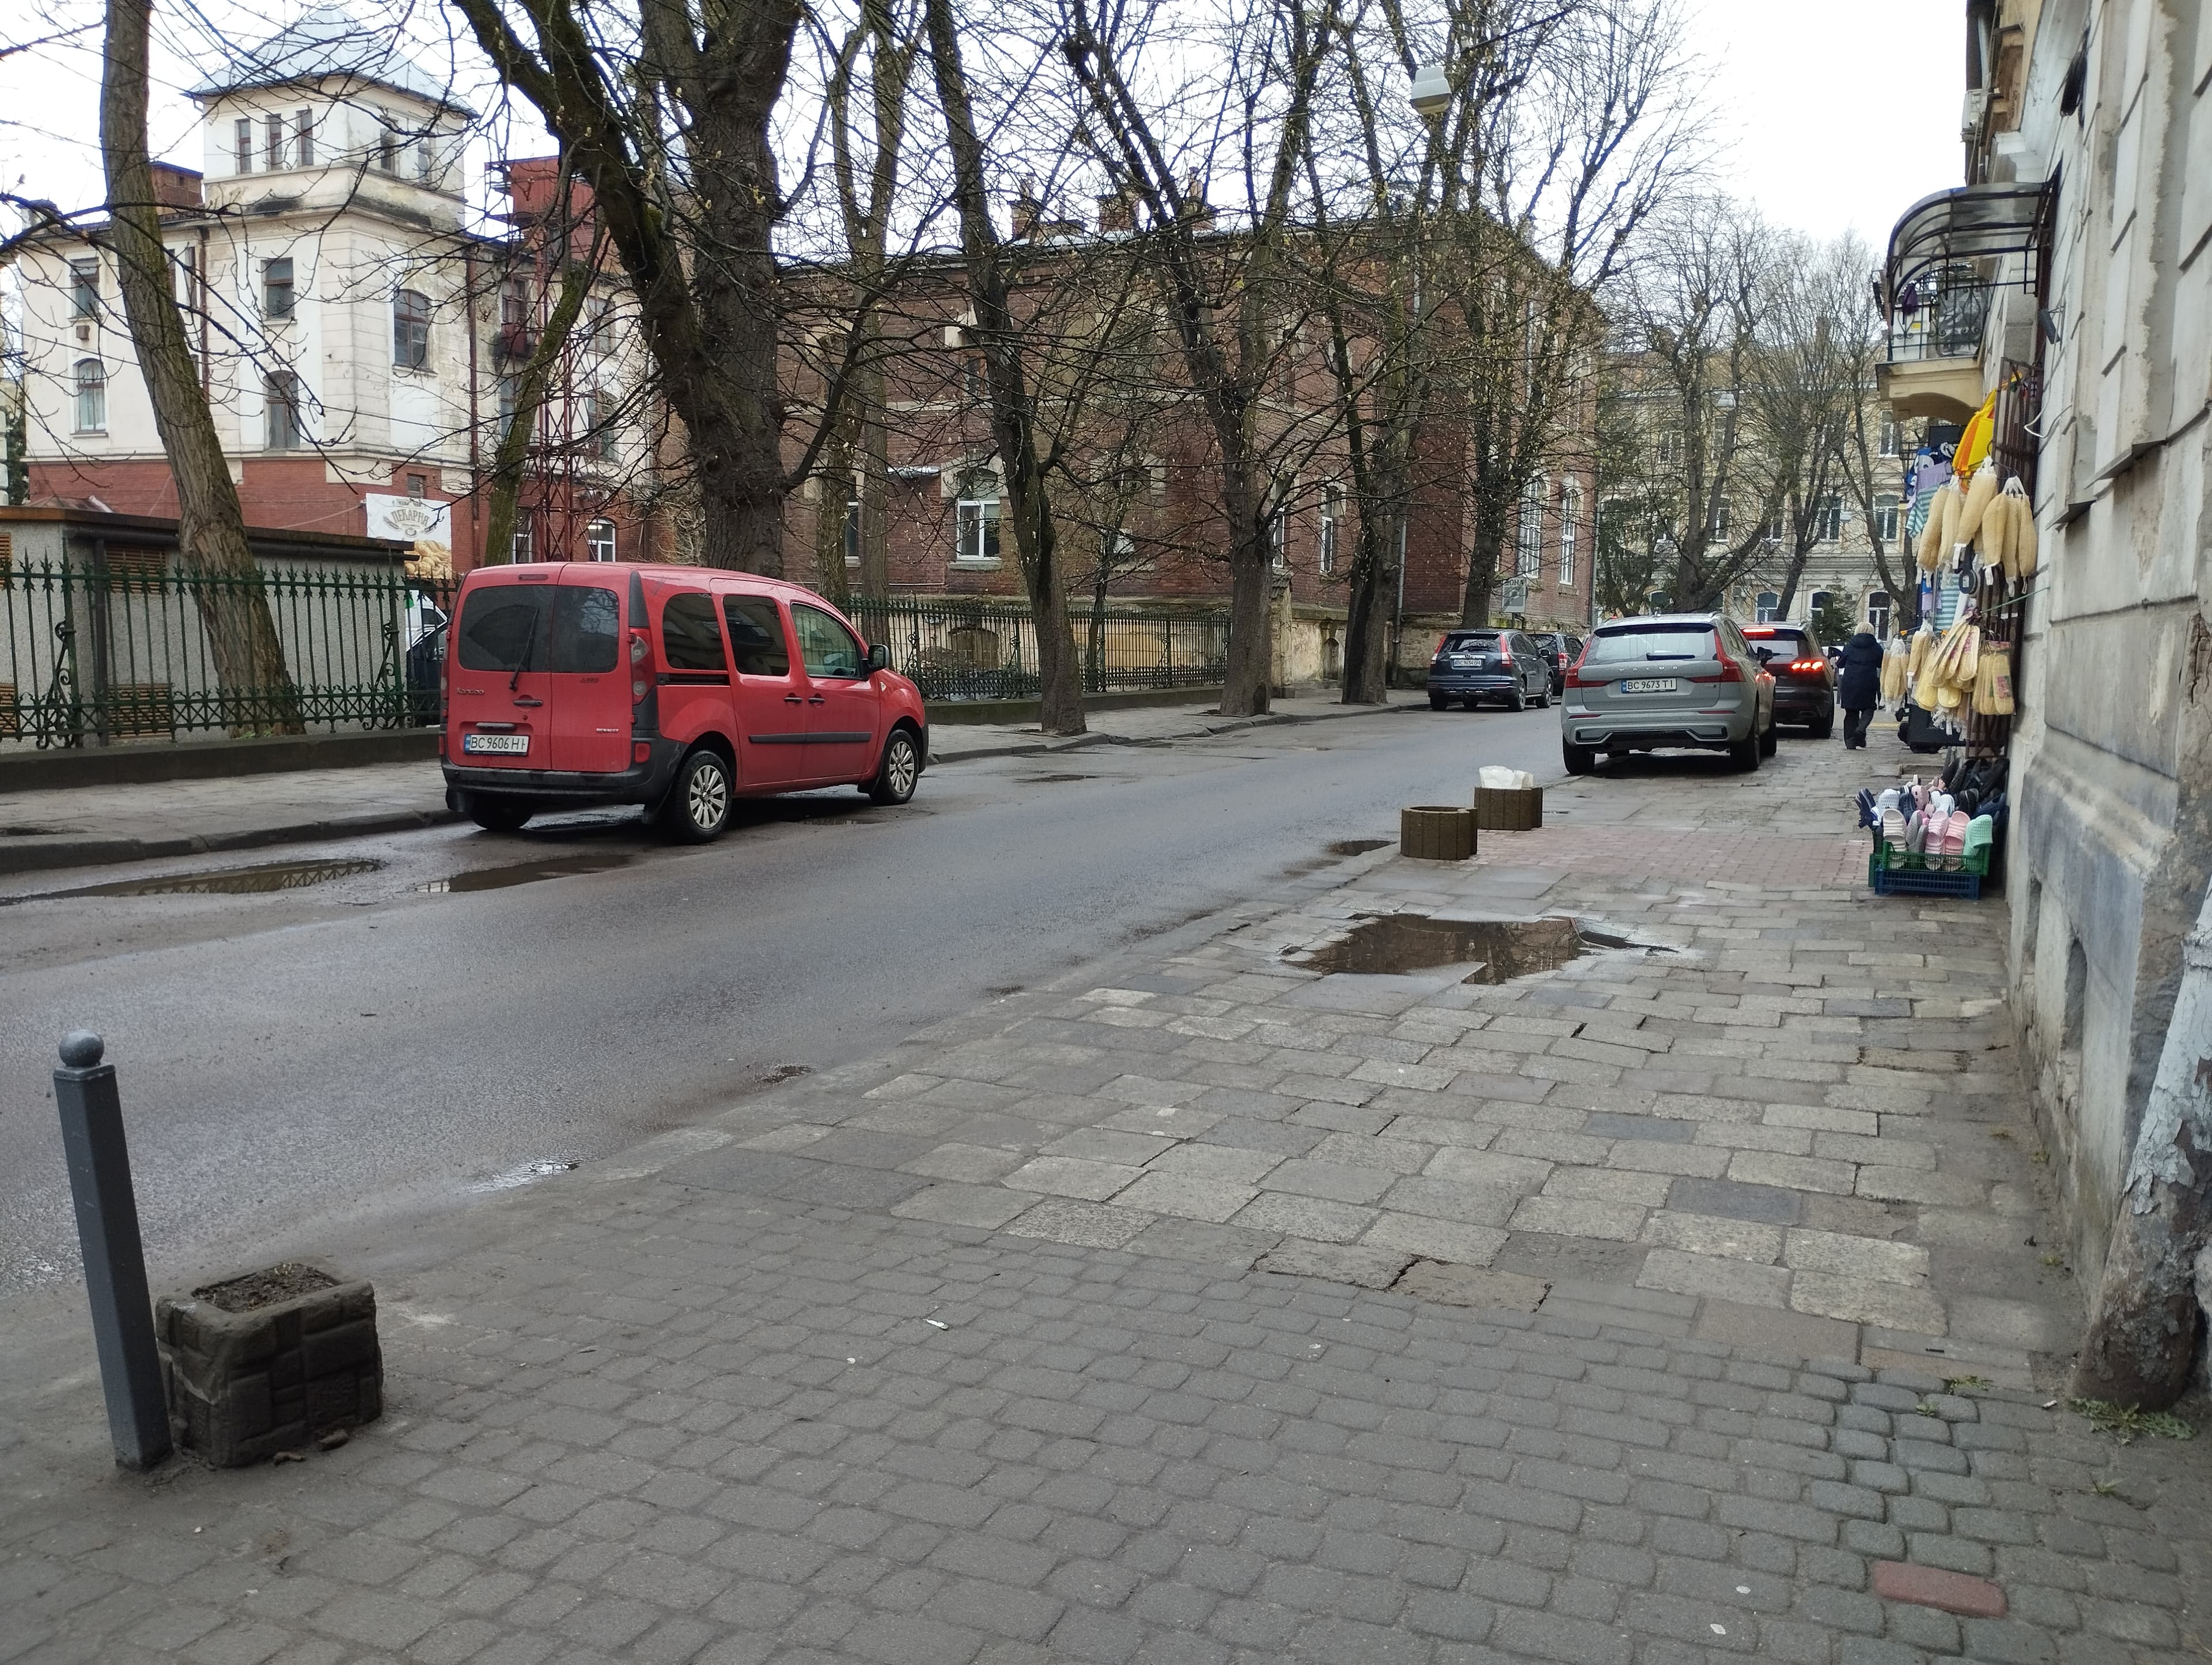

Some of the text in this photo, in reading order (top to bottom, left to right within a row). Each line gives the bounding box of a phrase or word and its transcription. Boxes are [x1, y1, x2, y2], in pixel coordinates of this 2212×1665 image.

[391, 509, 430, 526] ПЕКАРНЯ
[1627, 681, 1639, 690] BC
[1641, 680, 1660, 689] 9673
[471, 737, 485, 749] BC
[487, 737, 510, 749] 9606
